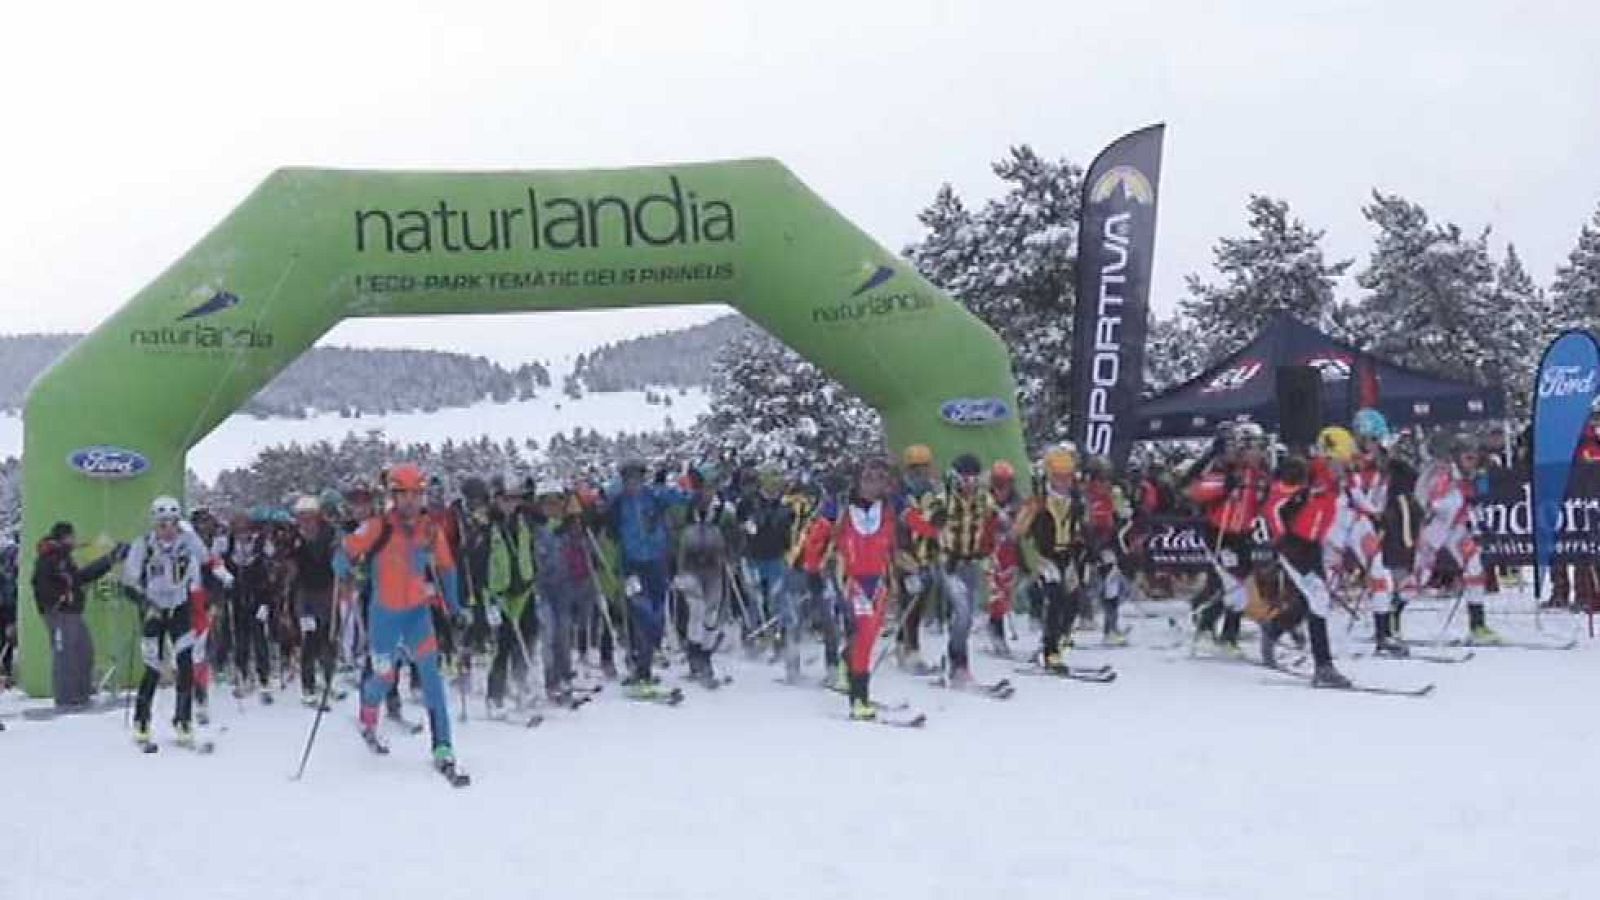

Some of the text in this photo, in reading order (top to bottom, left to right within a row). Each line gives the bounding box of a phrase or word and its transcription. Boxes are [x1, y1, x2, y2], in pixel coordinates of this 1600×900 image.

[354, 175, 735, 254] naturlandia
[640, 261, 735, 283] PIRINEUS
[1086, 212, 1132, 456] SPORTIVA
[1539, 366, 1596, 397] Ford
[80, 449, 137, 471] Ford
